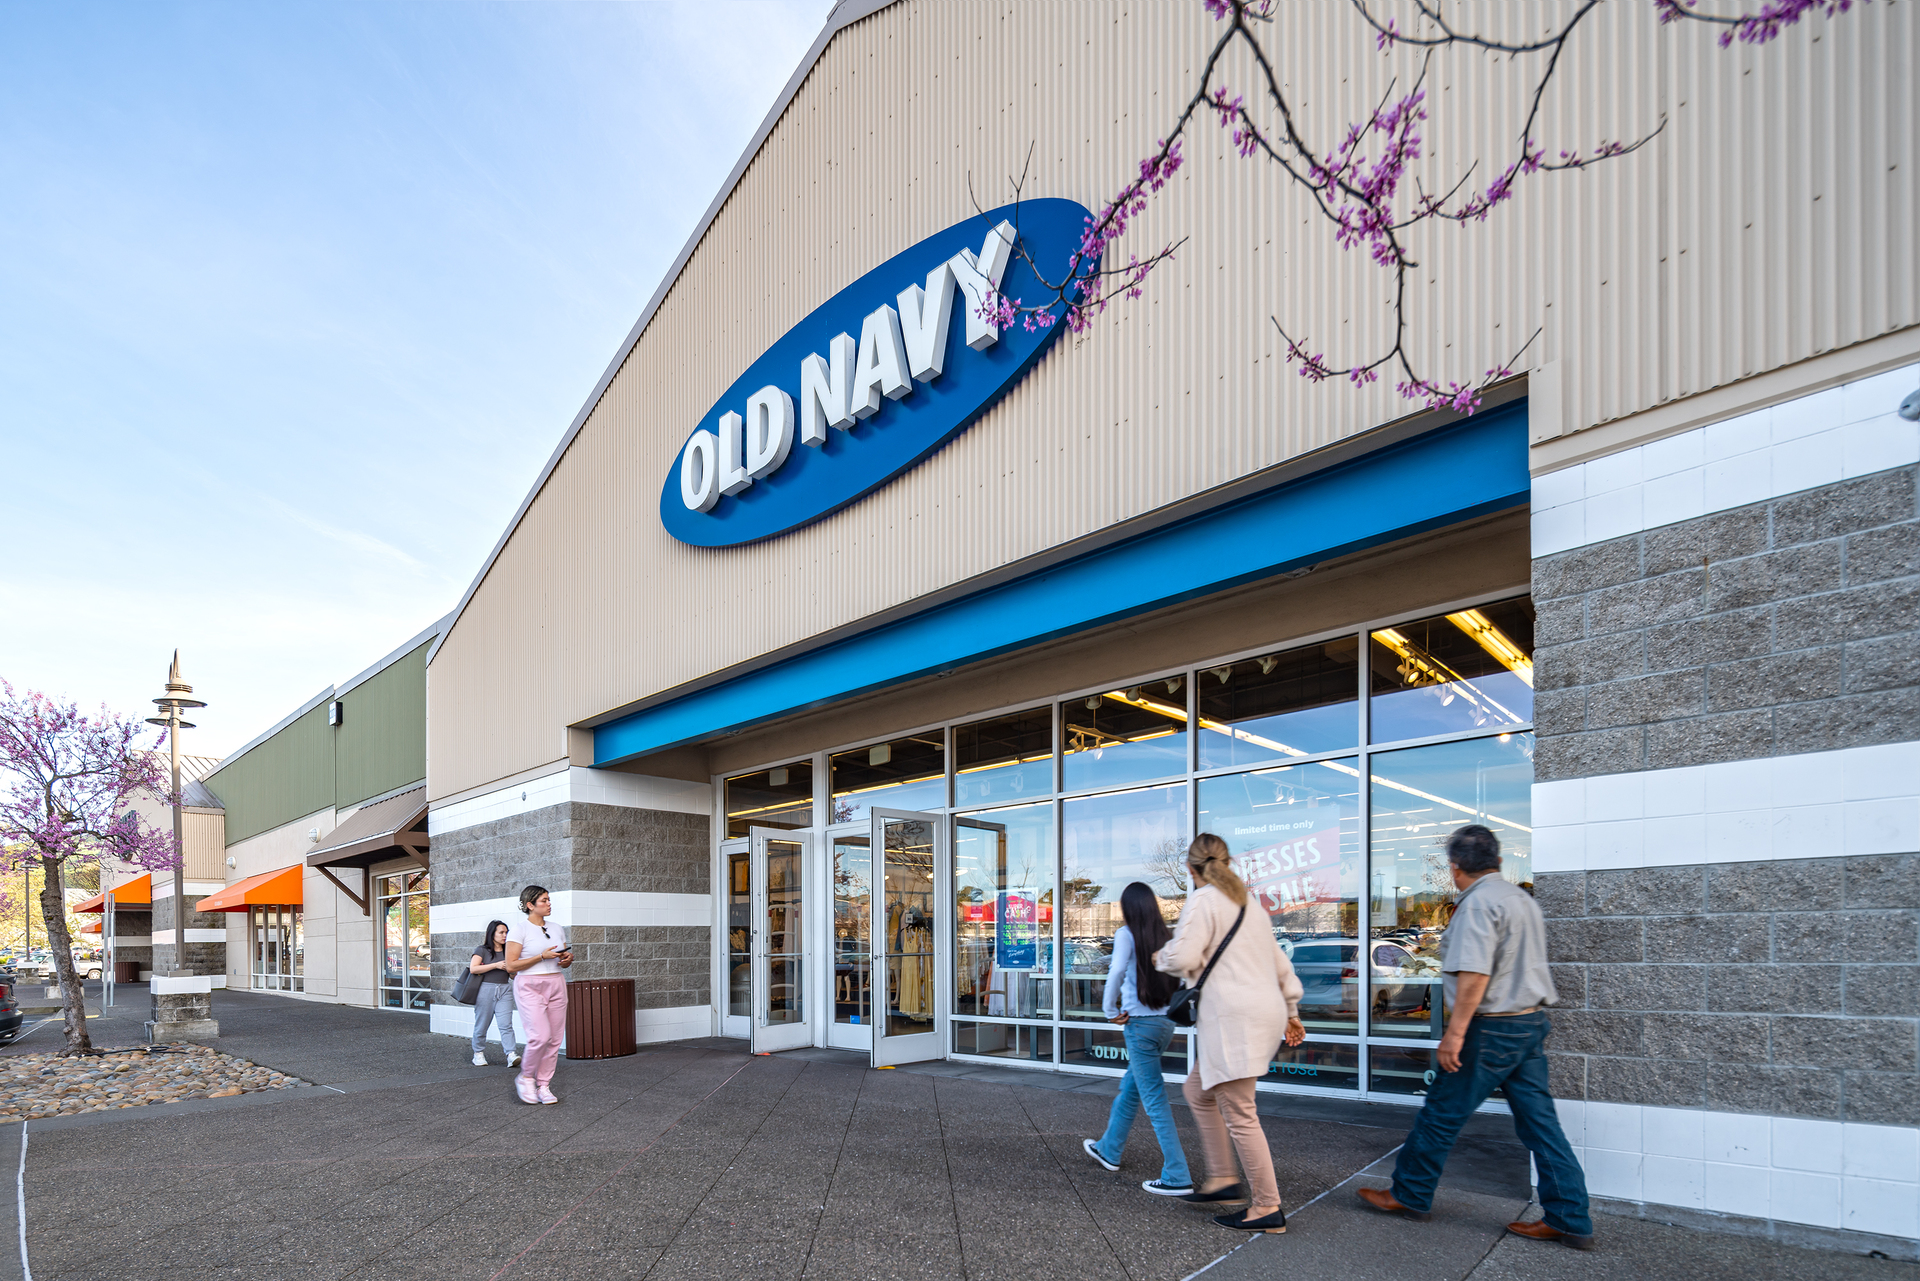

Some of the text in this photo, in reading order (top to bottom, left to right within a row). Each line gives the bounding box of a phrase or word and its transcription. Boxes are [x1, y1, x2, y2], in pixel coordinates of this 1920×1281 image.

[680, 219, 1017, 513] OLD NAVY
[1234, 820, 1315, 835] limited time only
[1266, 877, 1316, 911] SALE
[1095, 1045, 1119, 1060] OLD
[1281, 1062, 1318, 1076] rosa
